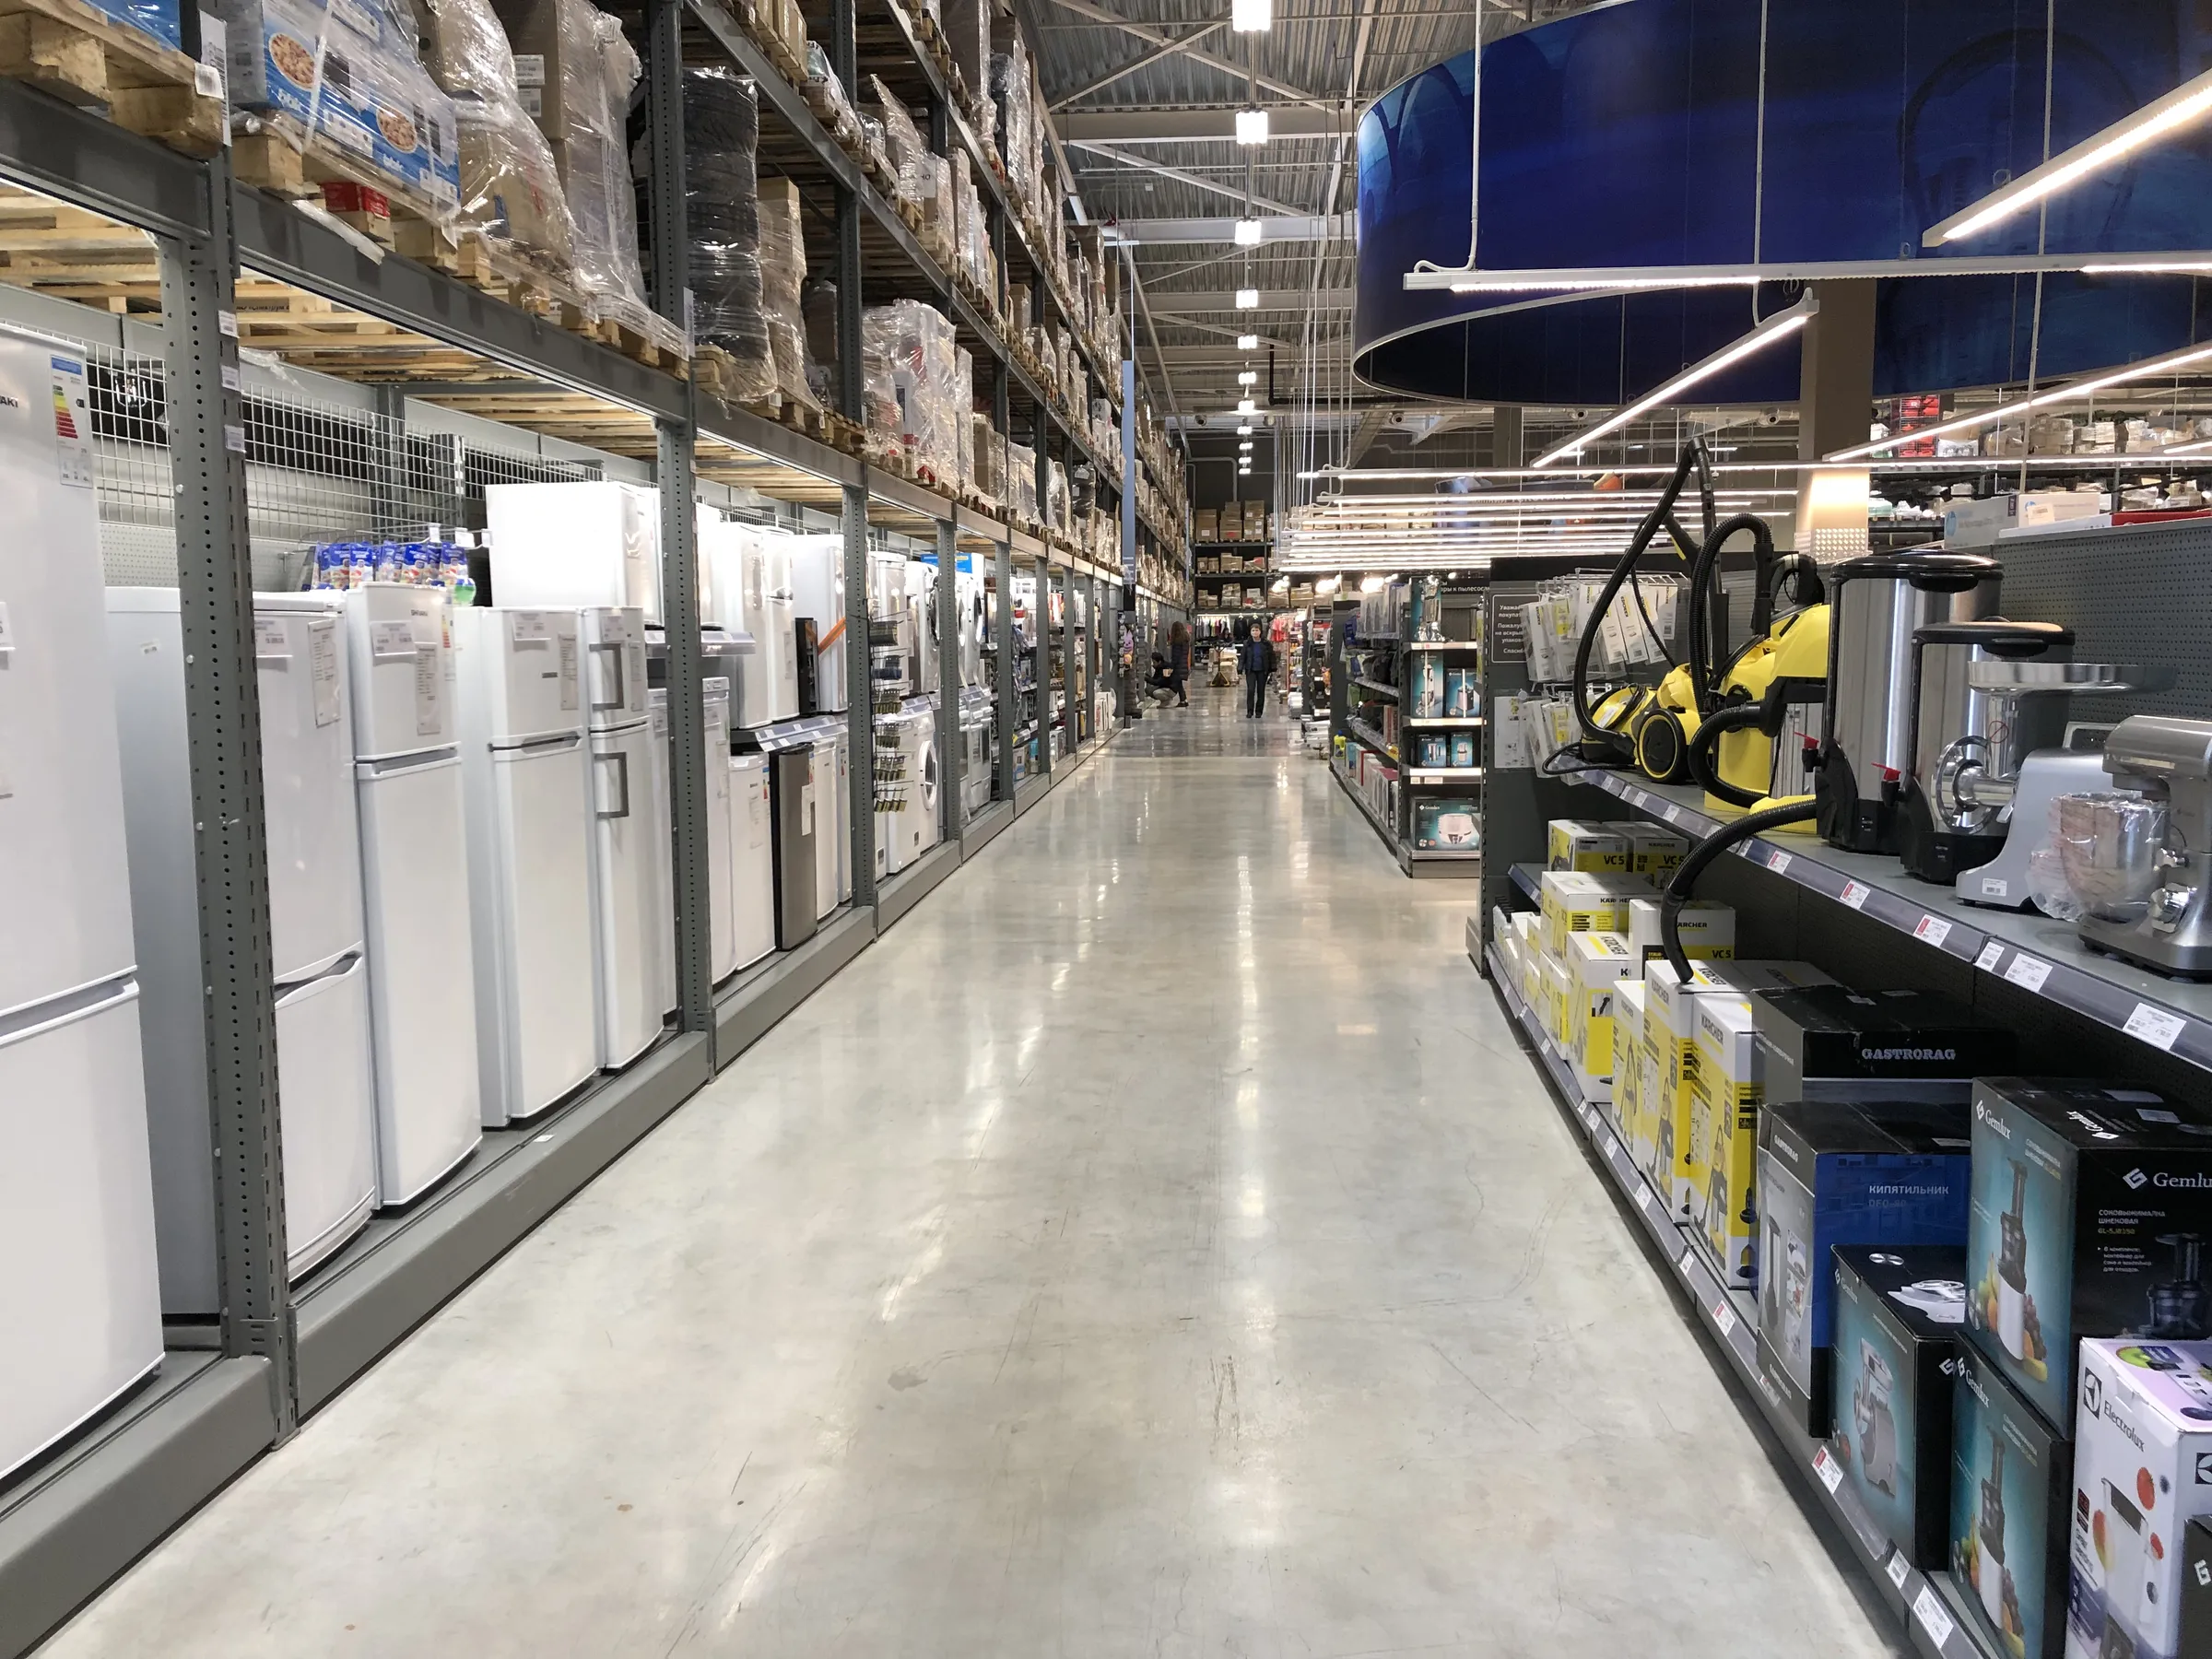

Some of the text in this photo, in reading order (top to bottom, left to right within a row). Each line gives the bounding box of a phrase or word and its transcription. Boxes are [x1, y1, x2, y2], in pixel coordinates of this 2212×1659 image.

[0, 395, 18, 408] AKI
[1862, 1048, 1956, 1060] GASTRORAG
[1985, 1109, 2011, 1140] Gemlux
[2153, 1171, 2212, 1189] Gemlu
[1868, 1184, 1949, 1195] КИПЯТИЛЬНИК
[2098, 1208, 2166, 1218] СОКОВЫЖИМАЛКА
[1966, 1369, 1990, 1408] Gemlux
[2103, 1399, 2146, 1453] Electrolux
